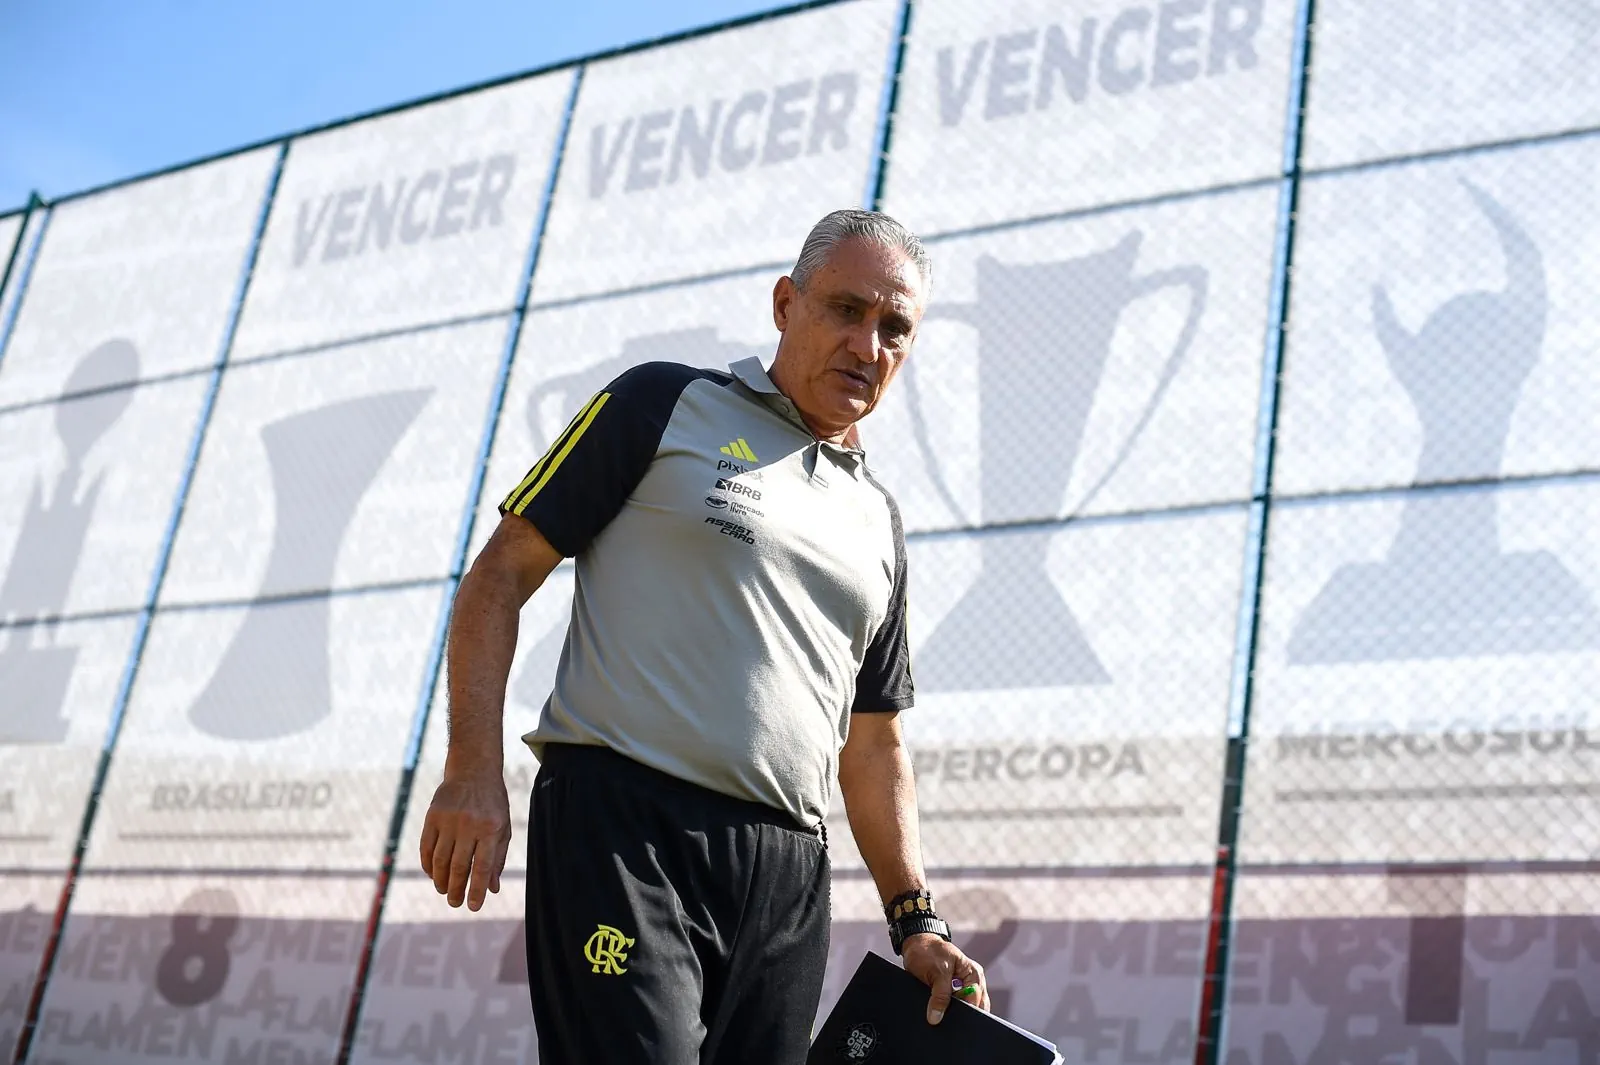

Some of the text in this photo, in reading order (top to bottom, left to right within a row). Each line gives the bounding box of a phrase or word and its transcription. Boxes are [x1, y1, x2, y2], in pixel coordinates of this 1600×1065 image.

[935, 0, 1264, 127] VENCER
[589, 73, 858, 199] VENCER
[292, 153, 516, 268] VENCER
[732, 483, 762, 500] BRB
[731, 502, 765, 518] mercado
[704, 517, 754, 536] ASSIST
[720, 527, 755, 545] CARD
[914, 743, 1145, 782] PERCOPA
[151, 781, 332, 813] BRASILEIRO
[155, 887, 240, 1007] 8
[856, 1037, 873, 1057] FLA
